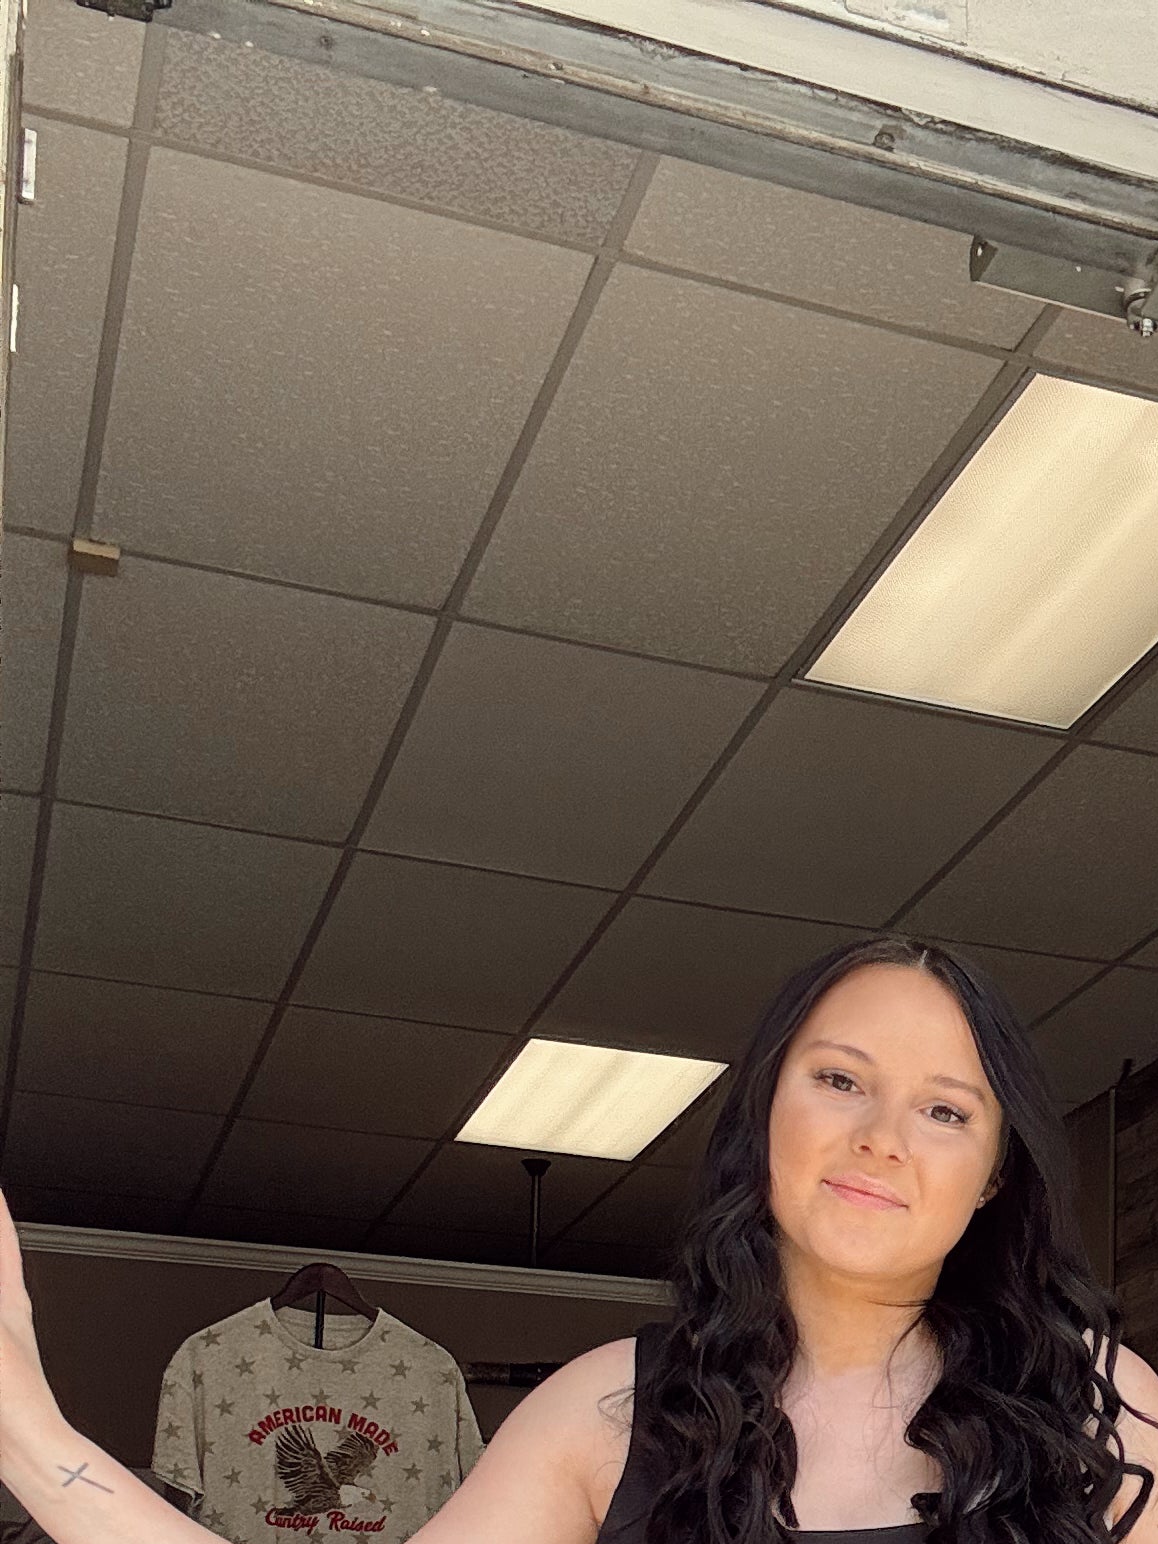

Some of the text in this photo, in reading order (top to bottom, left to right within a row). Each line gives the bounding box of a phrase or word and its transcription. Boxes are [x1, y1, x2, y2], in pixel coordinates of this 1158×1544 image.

[248, 1405, 399, 1457] AMERICAN MADE
[327, 1510, 387, 1532] Raised
